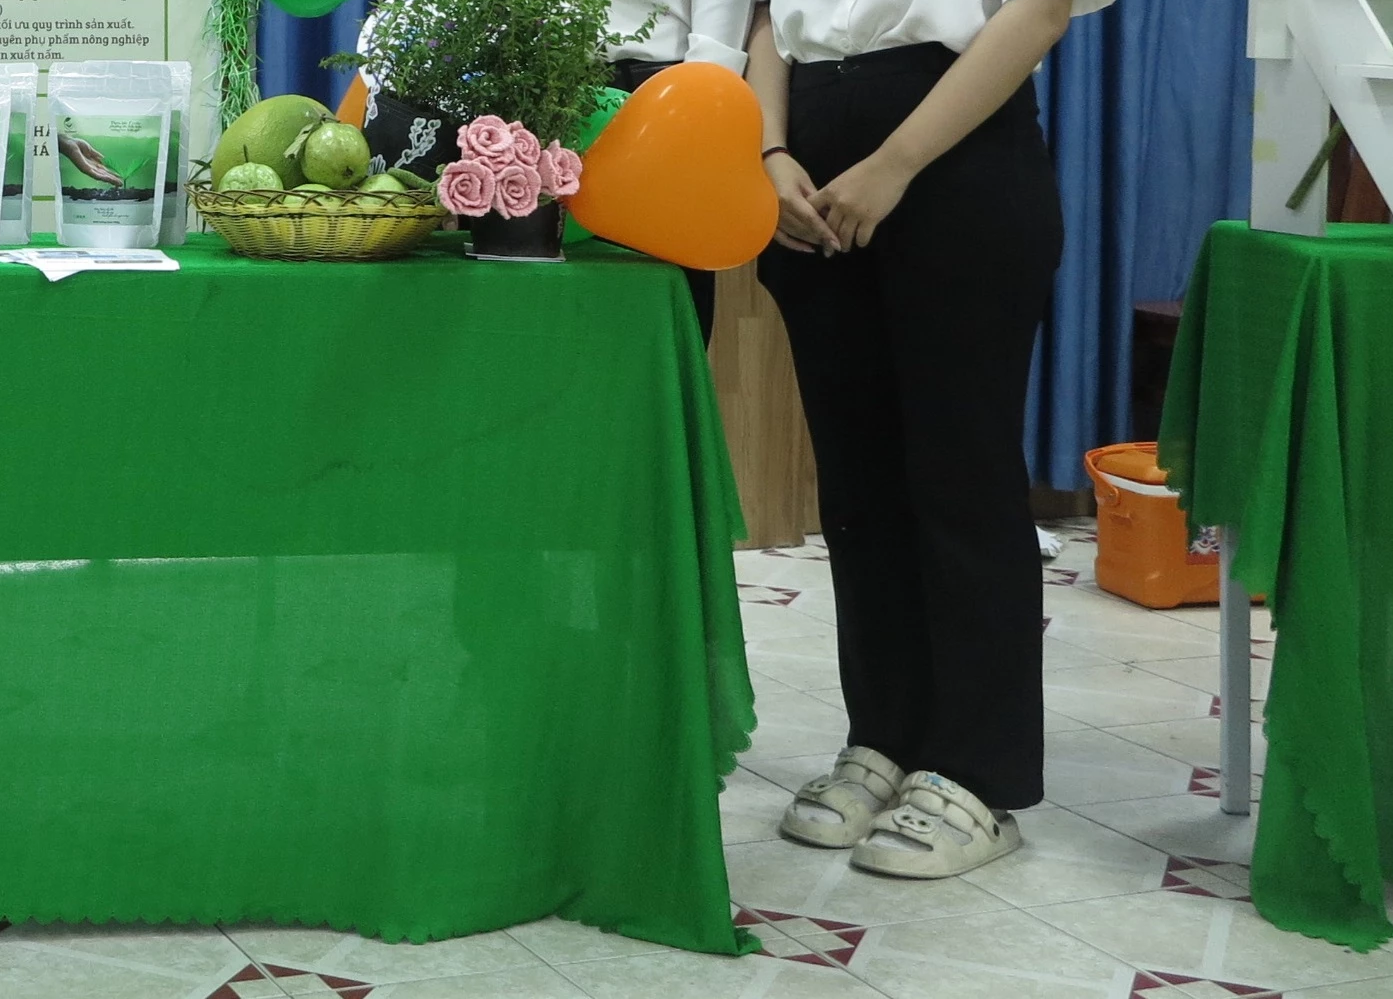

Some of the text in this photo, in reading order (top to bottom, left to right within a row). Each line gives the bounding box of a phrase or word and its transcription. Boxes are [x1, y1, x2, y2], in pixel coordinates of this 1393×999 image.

[32, 21, 53, 31] quy
[55, 19, 83, 29] trình
[25, 34, 46, 46] phụ
[82, 34, 109, 46] nông
[111, 34, 149, 46] nghiệp
[10, 48, 35, 60] xuất
